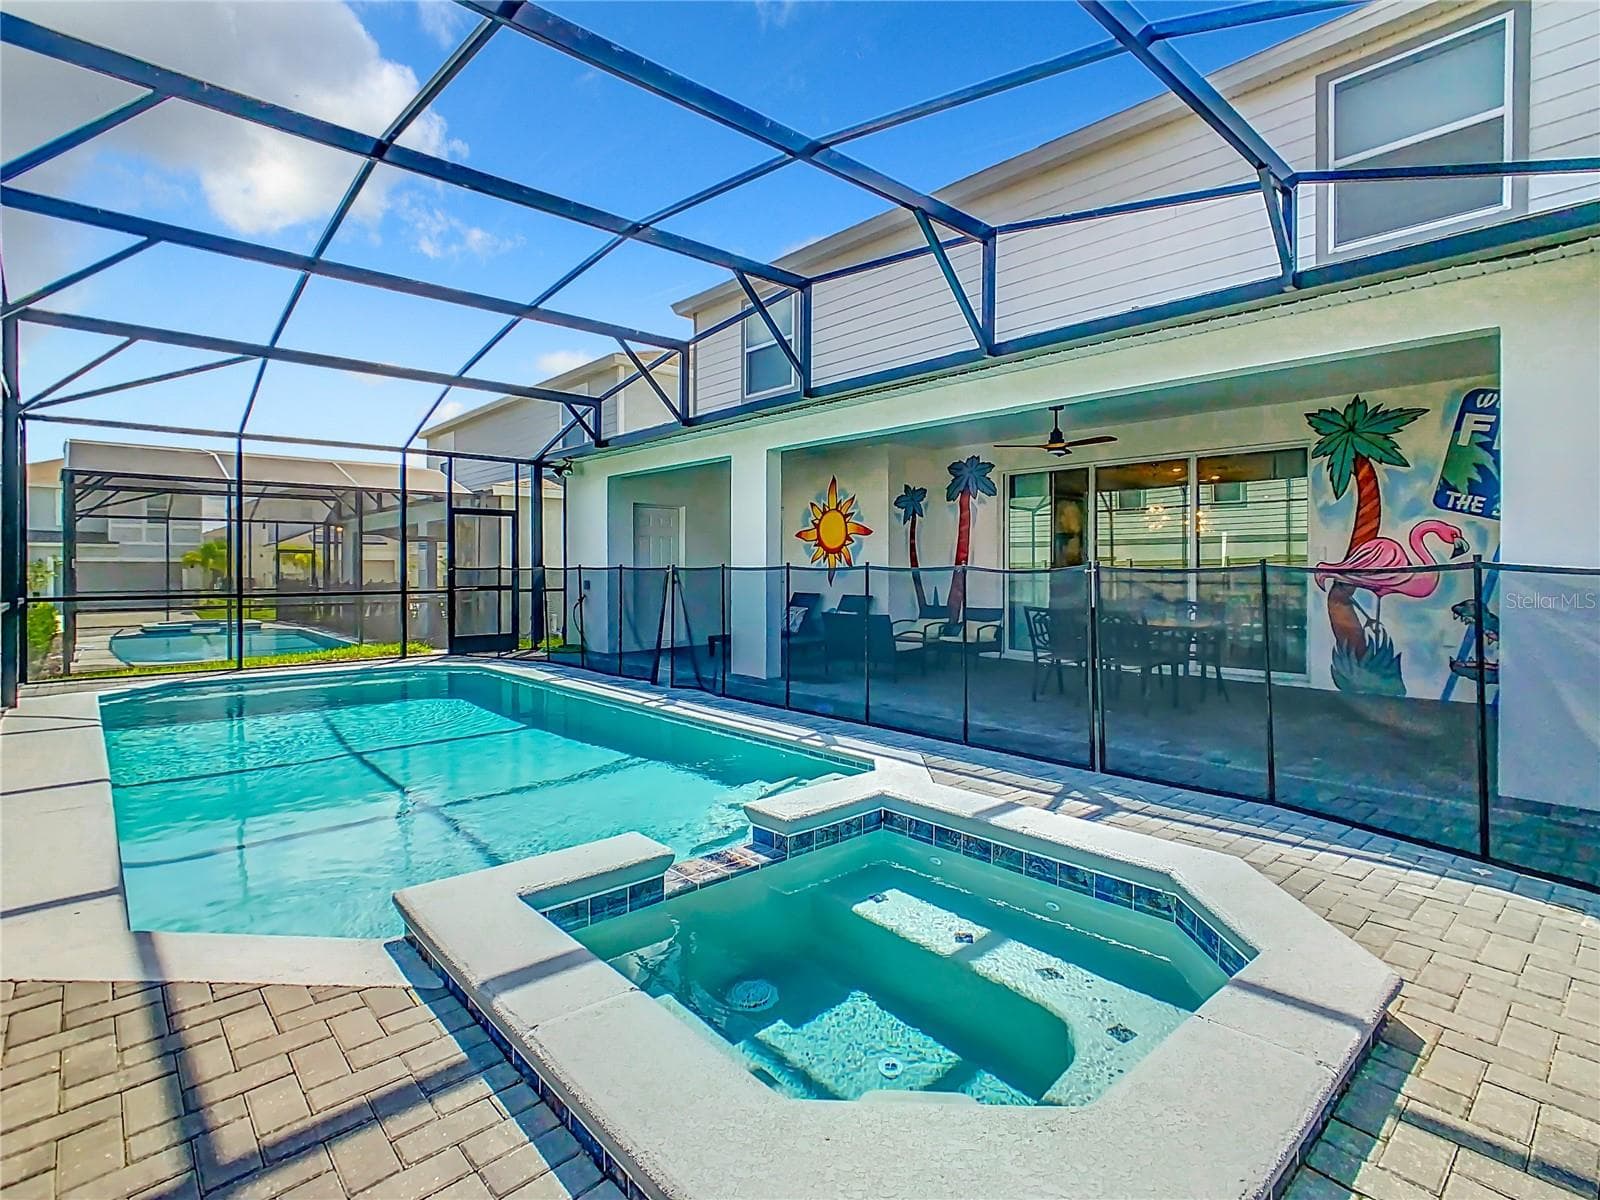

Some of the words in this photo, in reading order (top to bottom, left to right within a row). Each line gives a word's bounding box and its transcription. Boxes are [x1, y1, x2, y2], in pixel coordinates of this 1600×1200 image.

[1476, 392, 1500, 408] W
[1457, 412, 1501, 449] F
[1446, 490, 1487, 513] THE
